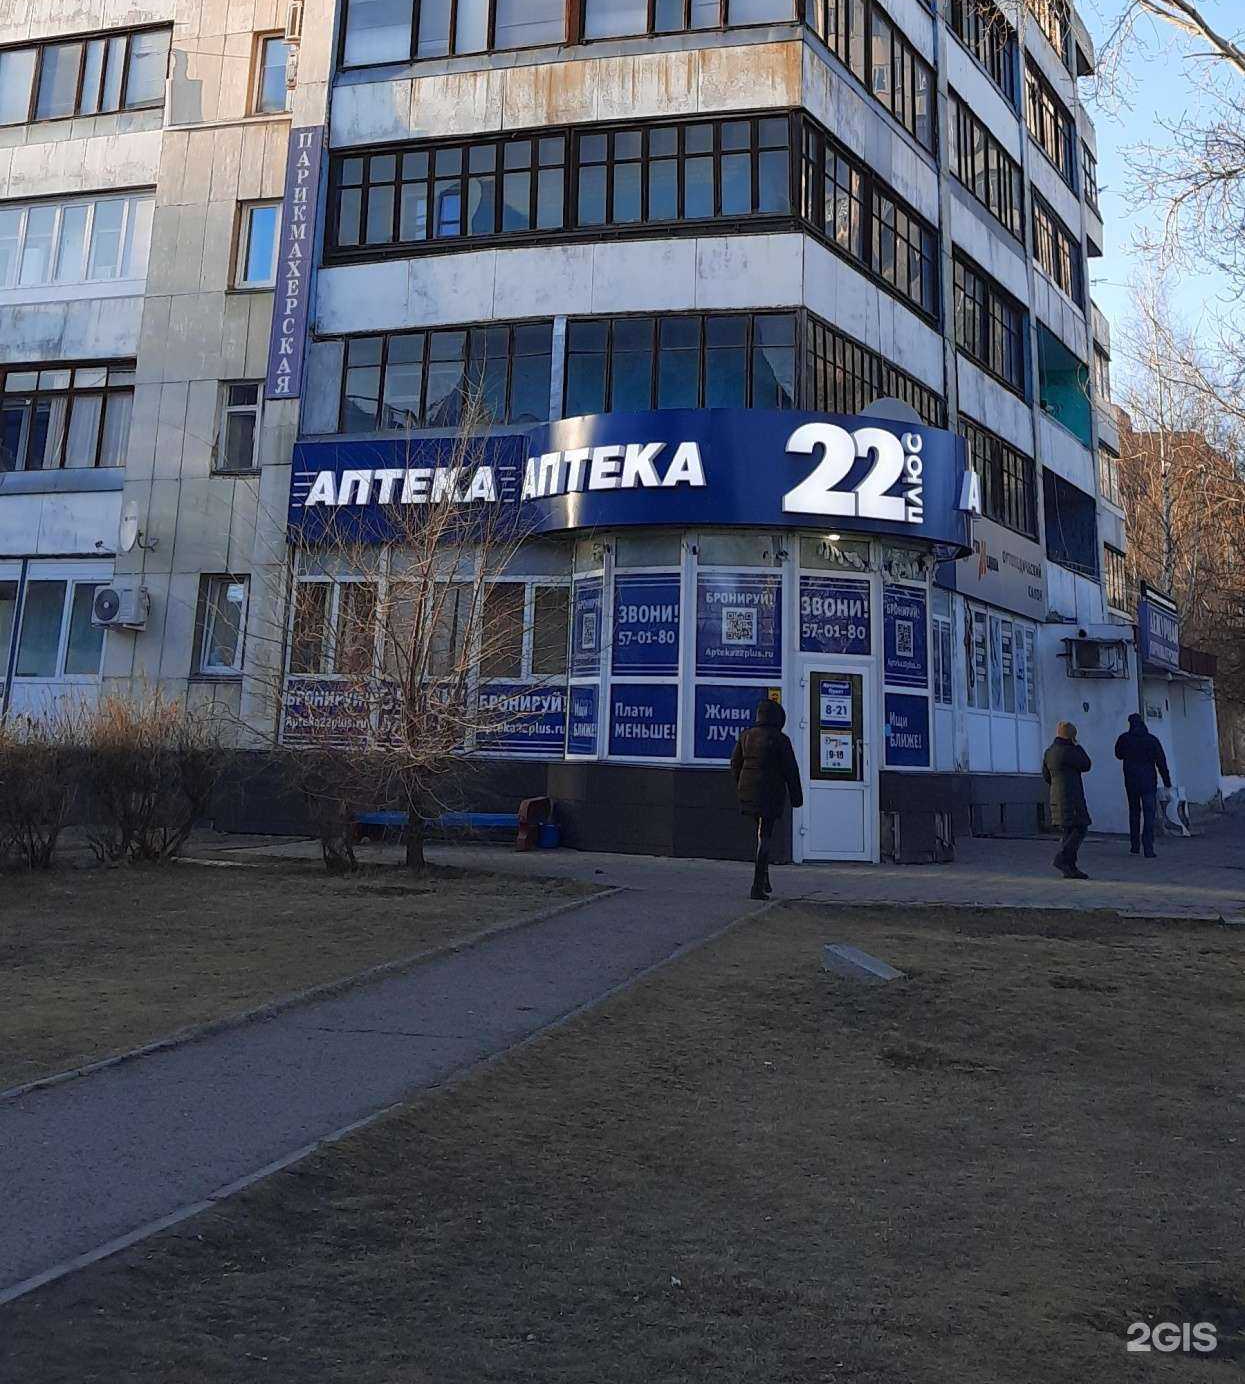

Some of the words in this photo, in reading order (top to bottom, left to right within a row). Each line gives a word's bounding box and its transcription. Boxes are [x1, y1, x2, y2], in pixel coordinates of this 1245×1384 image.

[273, 131, 313, 395] ПАРИКМАХЕРСКАЯ
[522, 441, 707, 501] АПТЕКА
[782, 422, 905, 522] 22
[901, 432, 924, 524] ПЛЮС
[304, 466, 497, 506] АПТЕКА
[705, 590, 774, 606] БРОНИРУЙ!
[618, 604, 679, 624] ЗВОНИ!
[800, 596, 869, 618] ЗВОНИ!
[618, 630, 675, 646] 57-01-80
[802, 622, 866, 640] 57-01-80
[614, 702, 653, 717] Плати
[704, 704, 750, 720] Живи
[825, 704, 848, 715] 8-21
[889, 711, 908, 728] Ищи
[614, 723, 676, 739] МЕНЬШЕ!
[707, 725, 746, 741] ЛУЧ
[890, 732, 922, 749] БЛИЖЕ!
